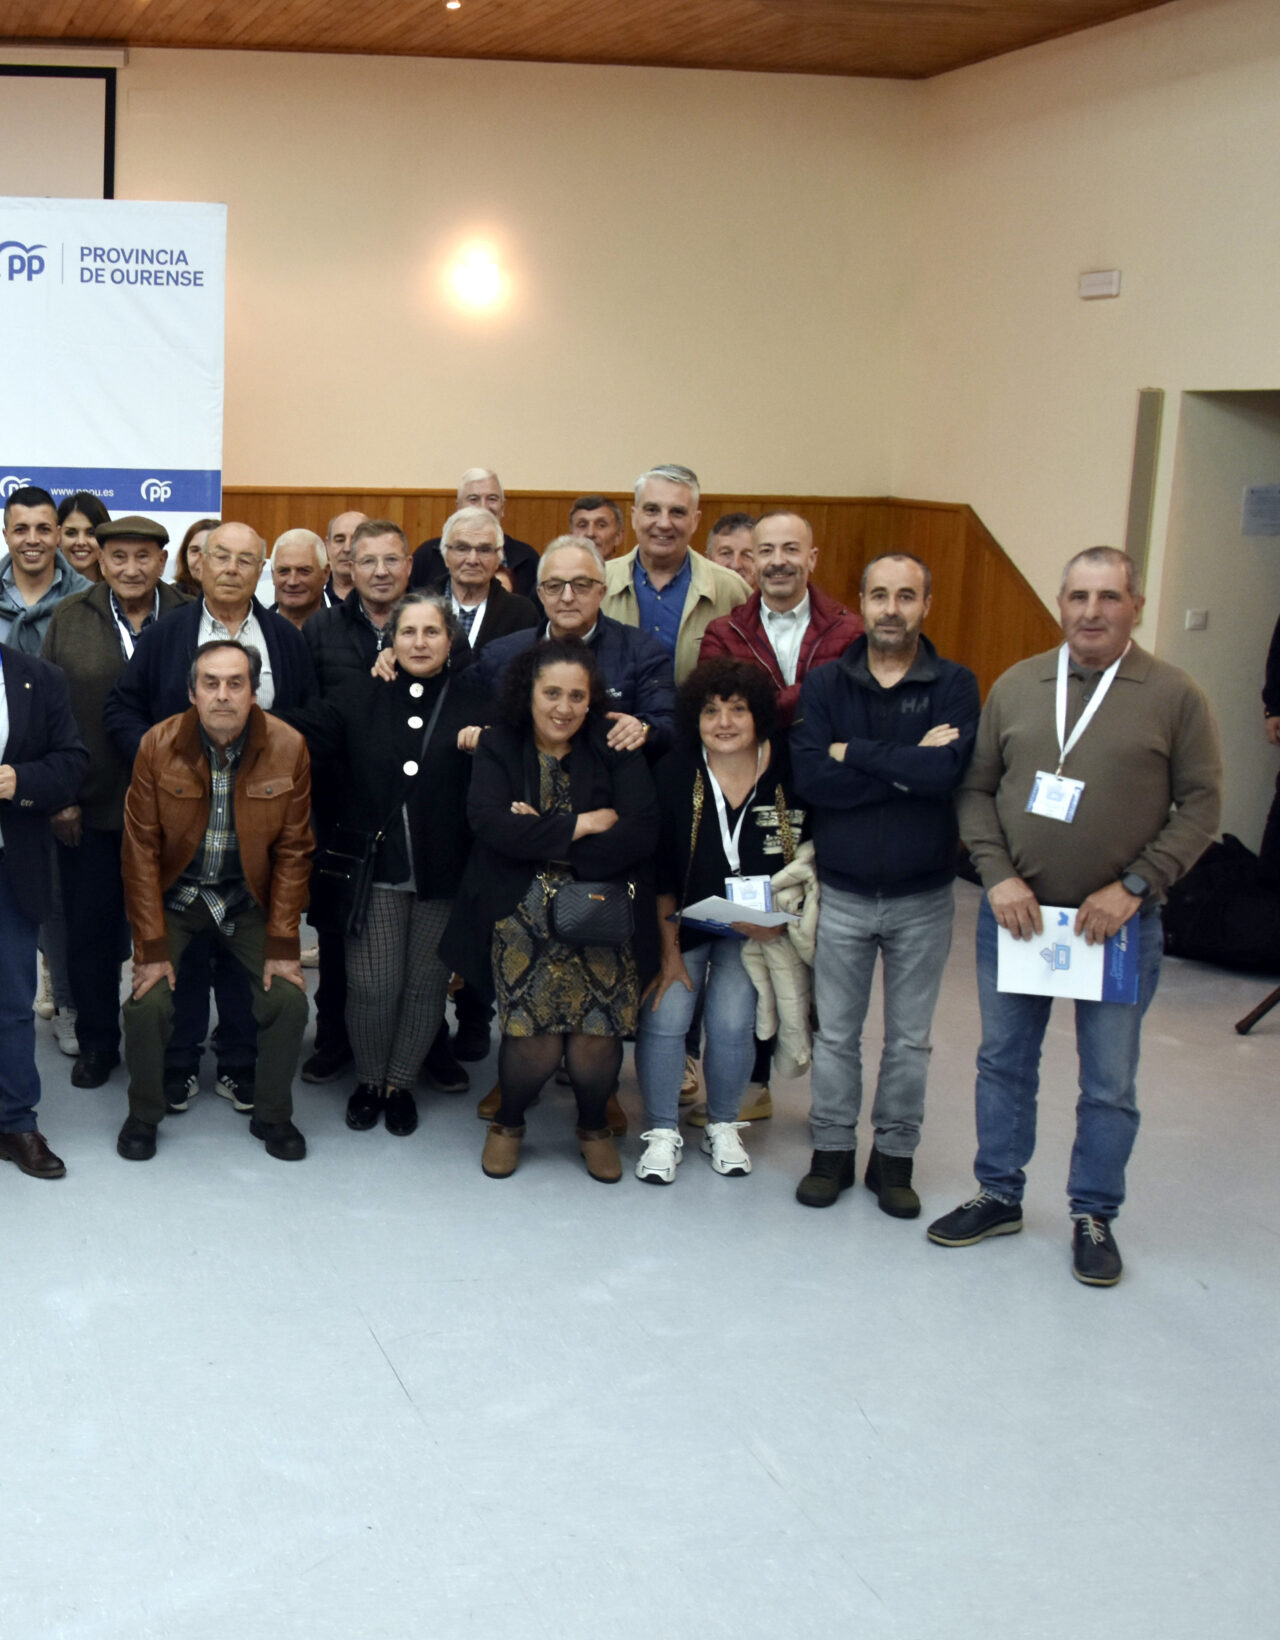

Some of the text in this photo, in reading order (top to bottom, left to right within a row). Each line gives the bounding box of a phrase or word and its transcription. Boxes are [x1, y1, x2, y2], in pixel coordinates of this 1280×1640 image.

[80, 246, 189, 266] PROVINCIA
[80, 267, 204, 287] DE OURENSE
